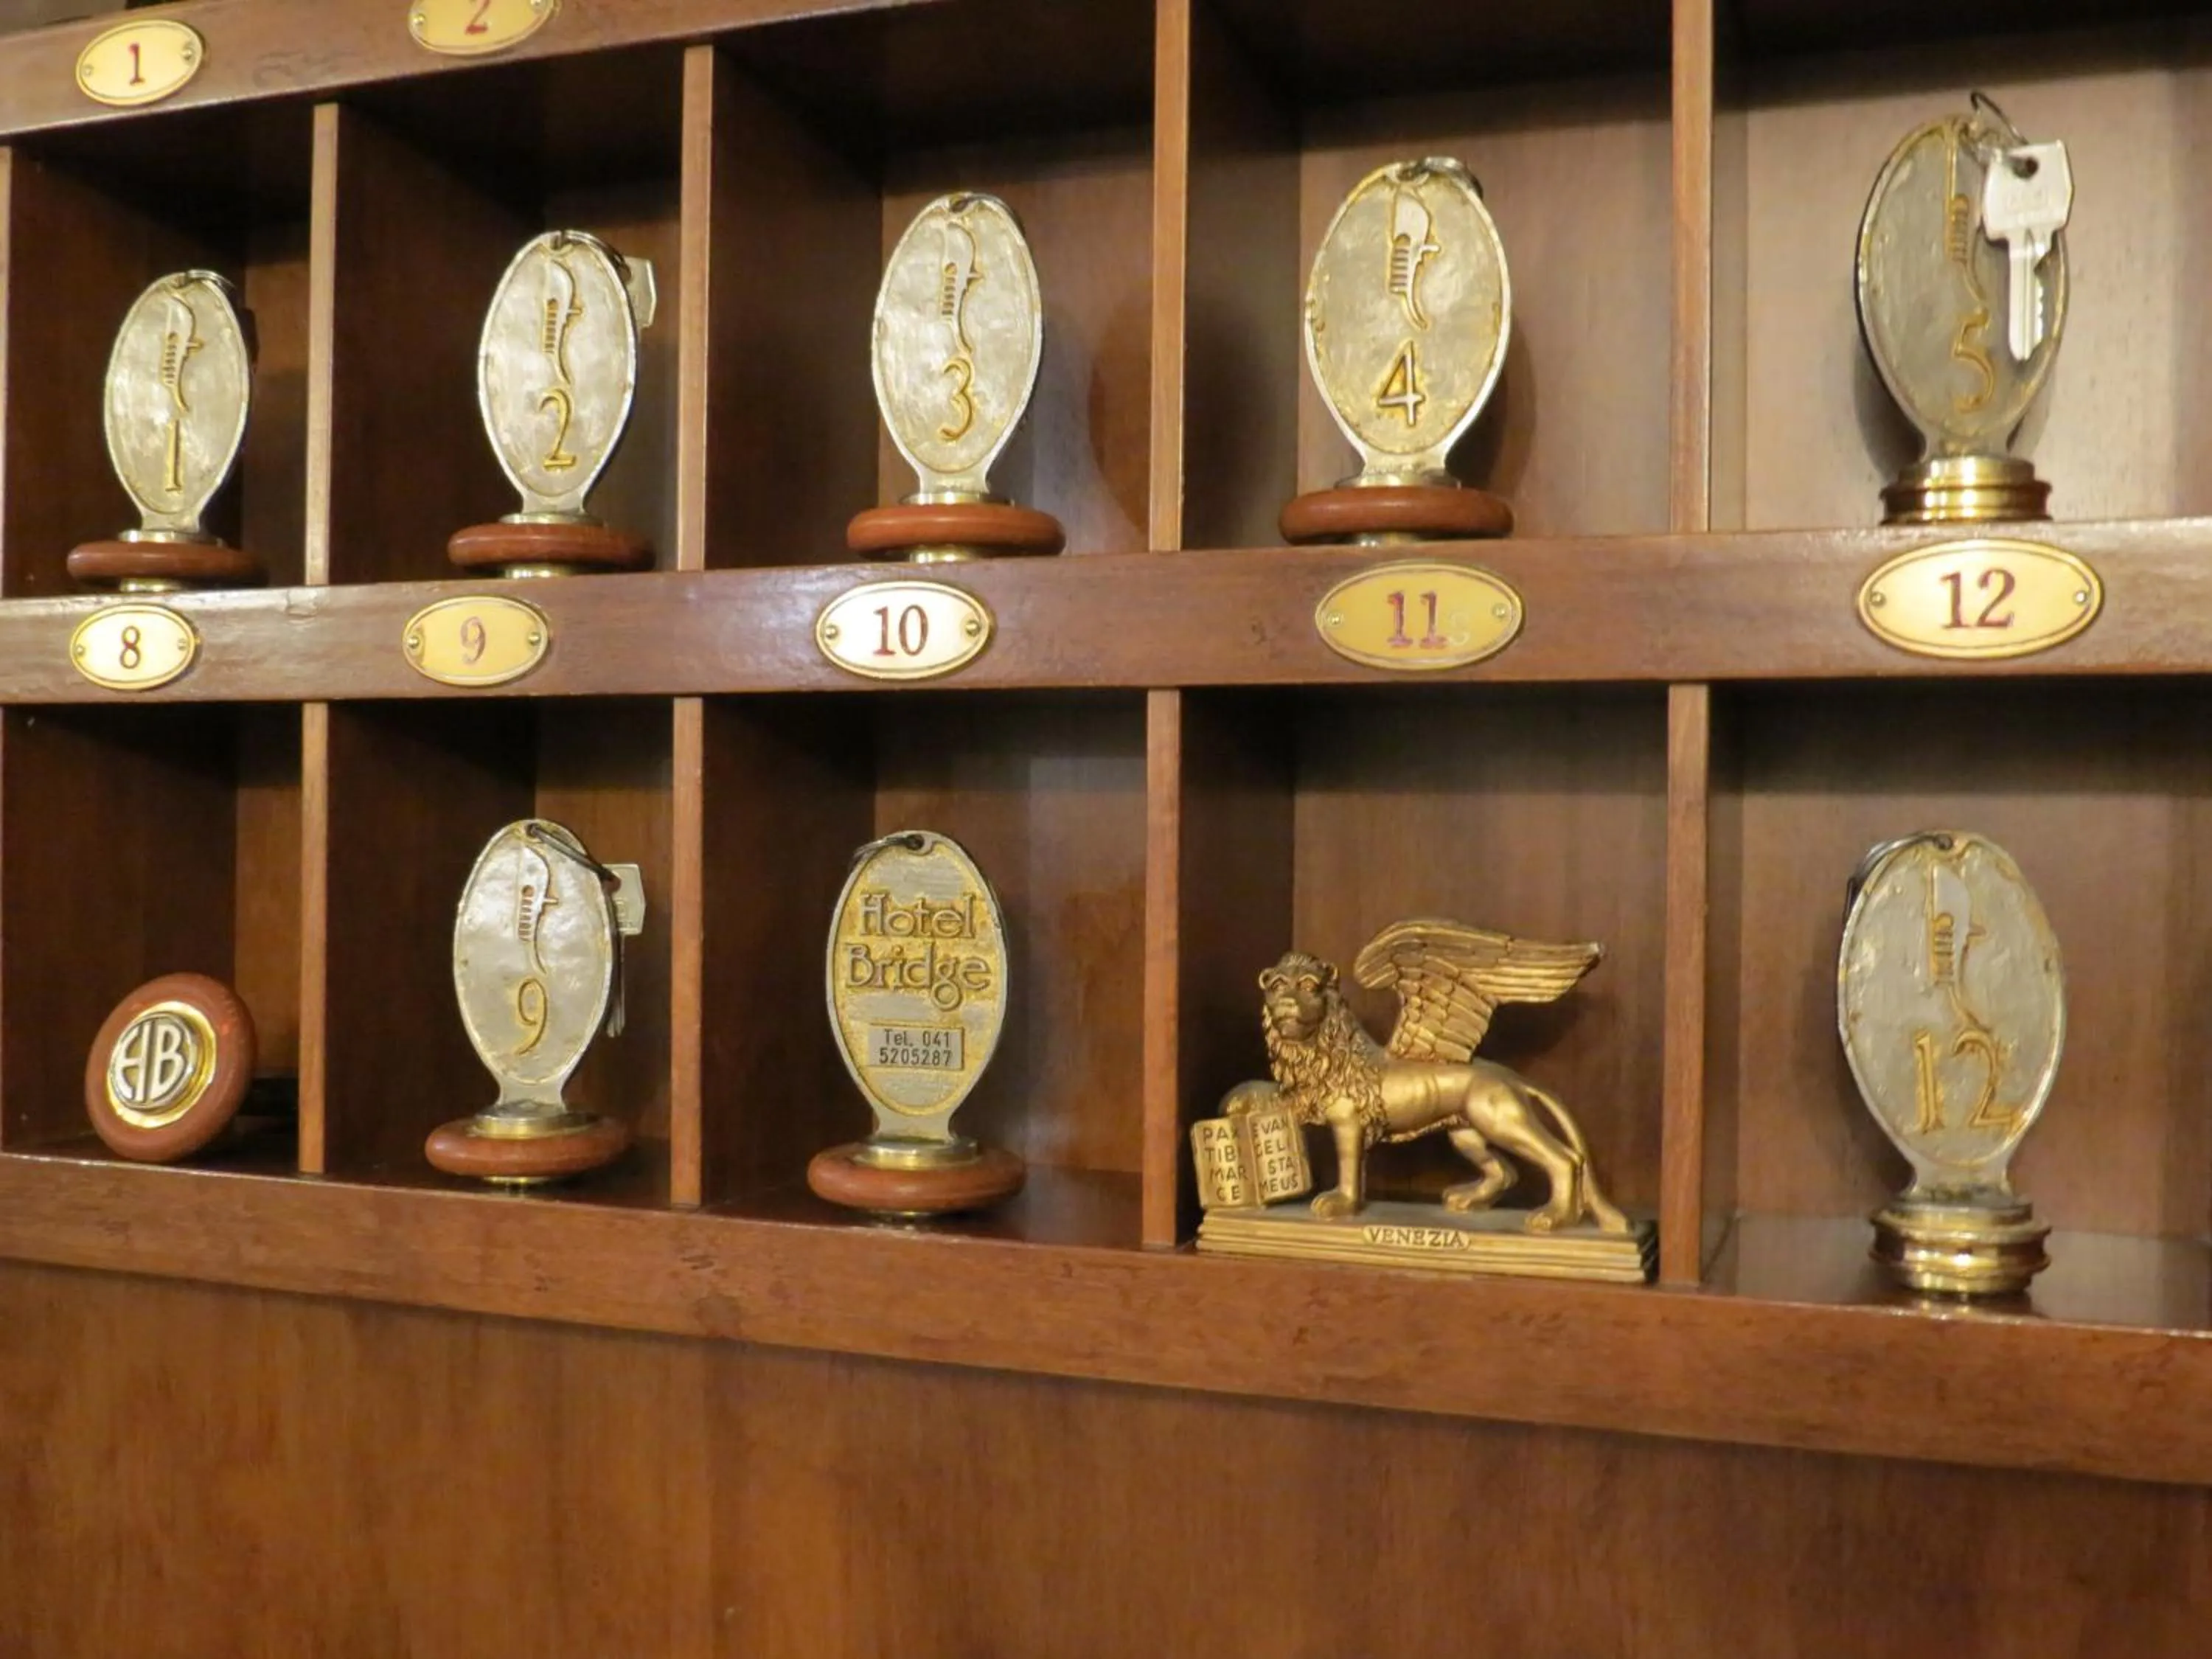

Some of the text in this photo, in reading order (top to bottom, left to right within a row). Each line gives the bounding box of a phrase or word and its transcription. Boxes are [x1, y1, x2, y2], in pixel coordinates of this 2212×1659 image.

[465, 0, 490, 35] 2
[129, 42, 145, 86] 1
[1377, 339, 1426, 428] 4
[1951, 310, 1993, 413] 5
[940, 357, 975, 441] 3
[165, 416, 184, 494] 1
[538, 388, 577, 470] 2
[1386, 591, 1449, 649] 11
[1940, 567, 2016, 630] 12
[120, 625, 140, 669] 8
[460, 616, 486, 667] 9
[873, 604, 929, 657] 10
[860, 891, 975, 939] Hotel
[846, 942, 991, 1012] Bridge
[518, 978, 547, 1056] 9
[885, 1030, 951, 1048] Tel. 041
[879, 1048, 952, 1066] 5205287
[1914, 1029, 2022, 1134] 12
[1368, 1227, 1464, 1248] VENEZIA
